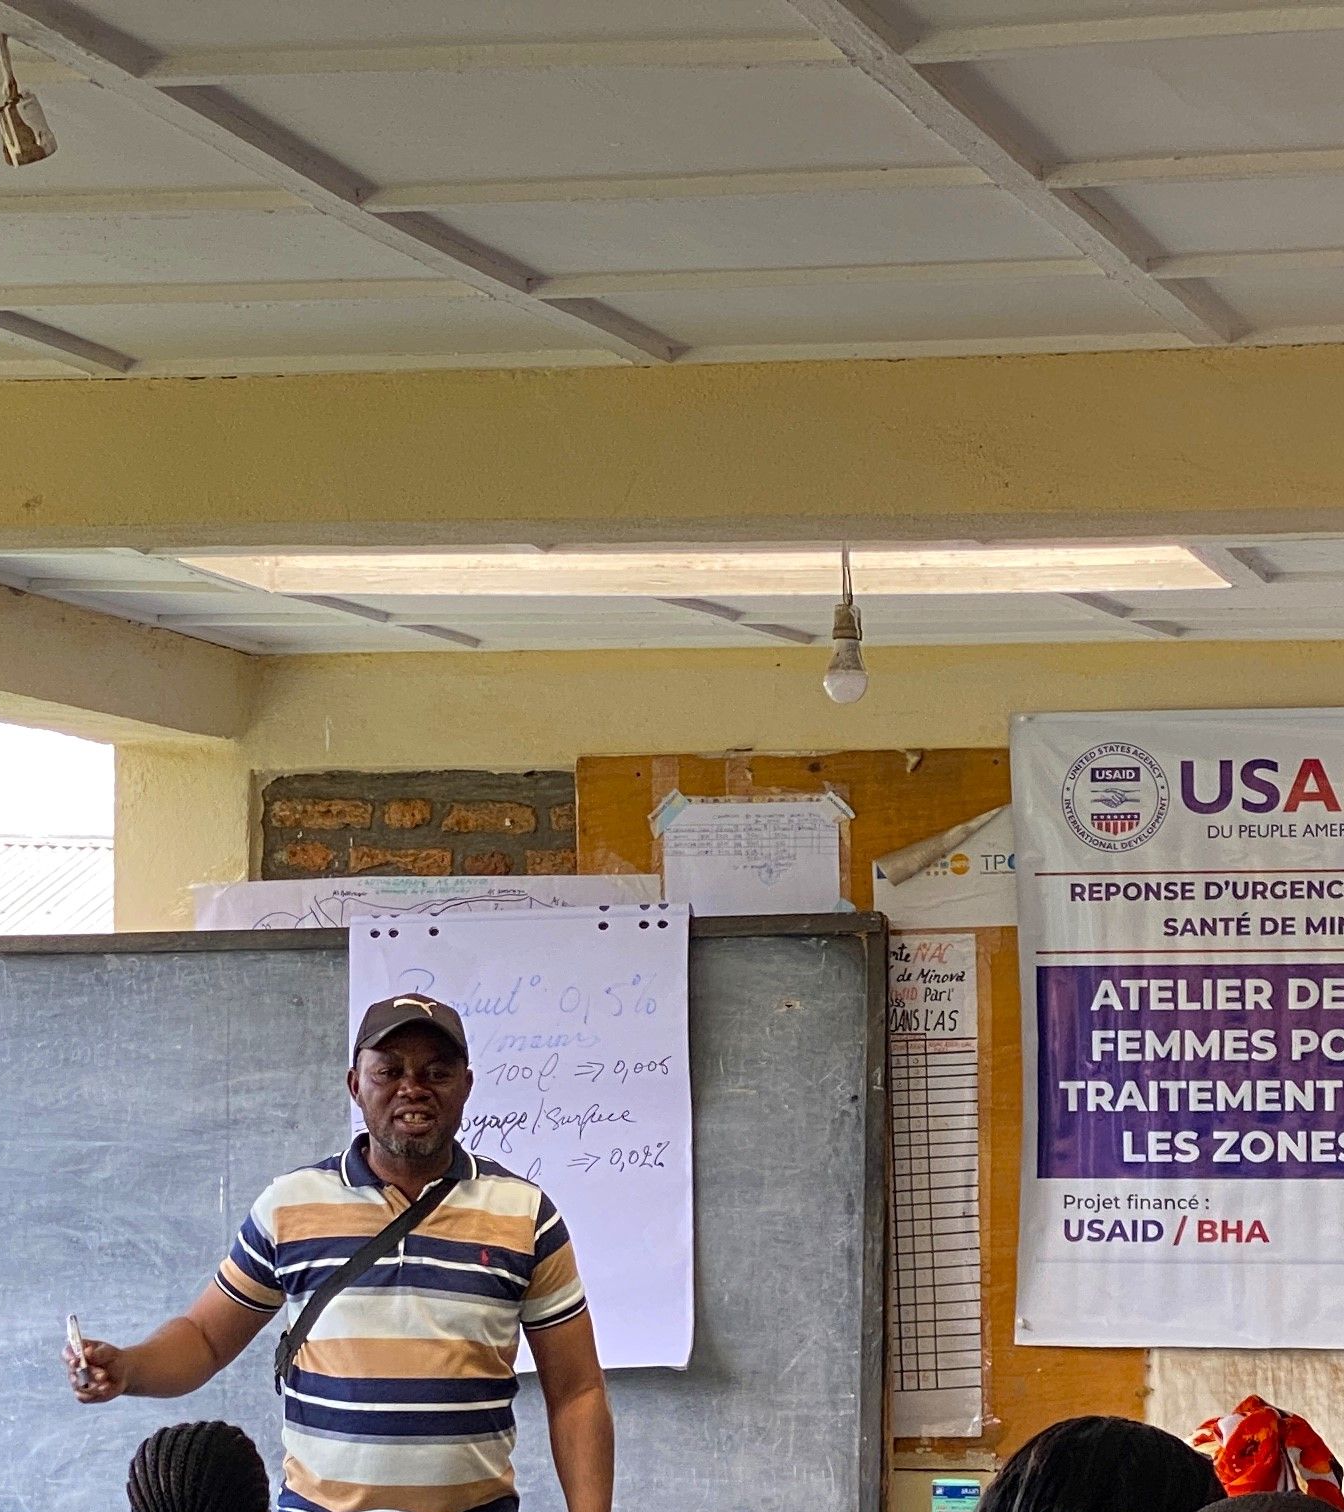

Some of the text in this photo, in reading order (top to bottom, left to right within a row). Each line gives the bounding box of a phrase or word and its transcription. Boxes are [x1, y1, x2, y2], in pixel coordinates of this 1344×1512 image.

[1069, 745, 1162, 781] UNITED STATES AGENCY
[1096, 769, 1135, 779] USAID
[1064, 797, 1167, 850] INTERNATIONAL DEVELOPMENT
[1207, 824, 1233, 839] DU
[1238, 823, 1297, 839] PEUPLE
[1070, 881, 1196, 902] REPONSE
[1163, 911, 1251, 937] SANTÉ
[1260, 916, 1296, 936] DE
[897, 968, 967, 984] de Minova
[1090, 978, 1273, 1011] ATELIER
[1091, 1028, 1278, 1062] FEMMES
[1058, 1079, 1344, 1112] TRAITEMENT
[1122, 1130, 1200, 1163] LES
[1063, 1193, 1121, 1214] Projet
[1126, 1193, 1200, 1211] financé
[1063, 1218, 1164, 1243] USAID
[1197, 1219, 1270, 1244] BHA
